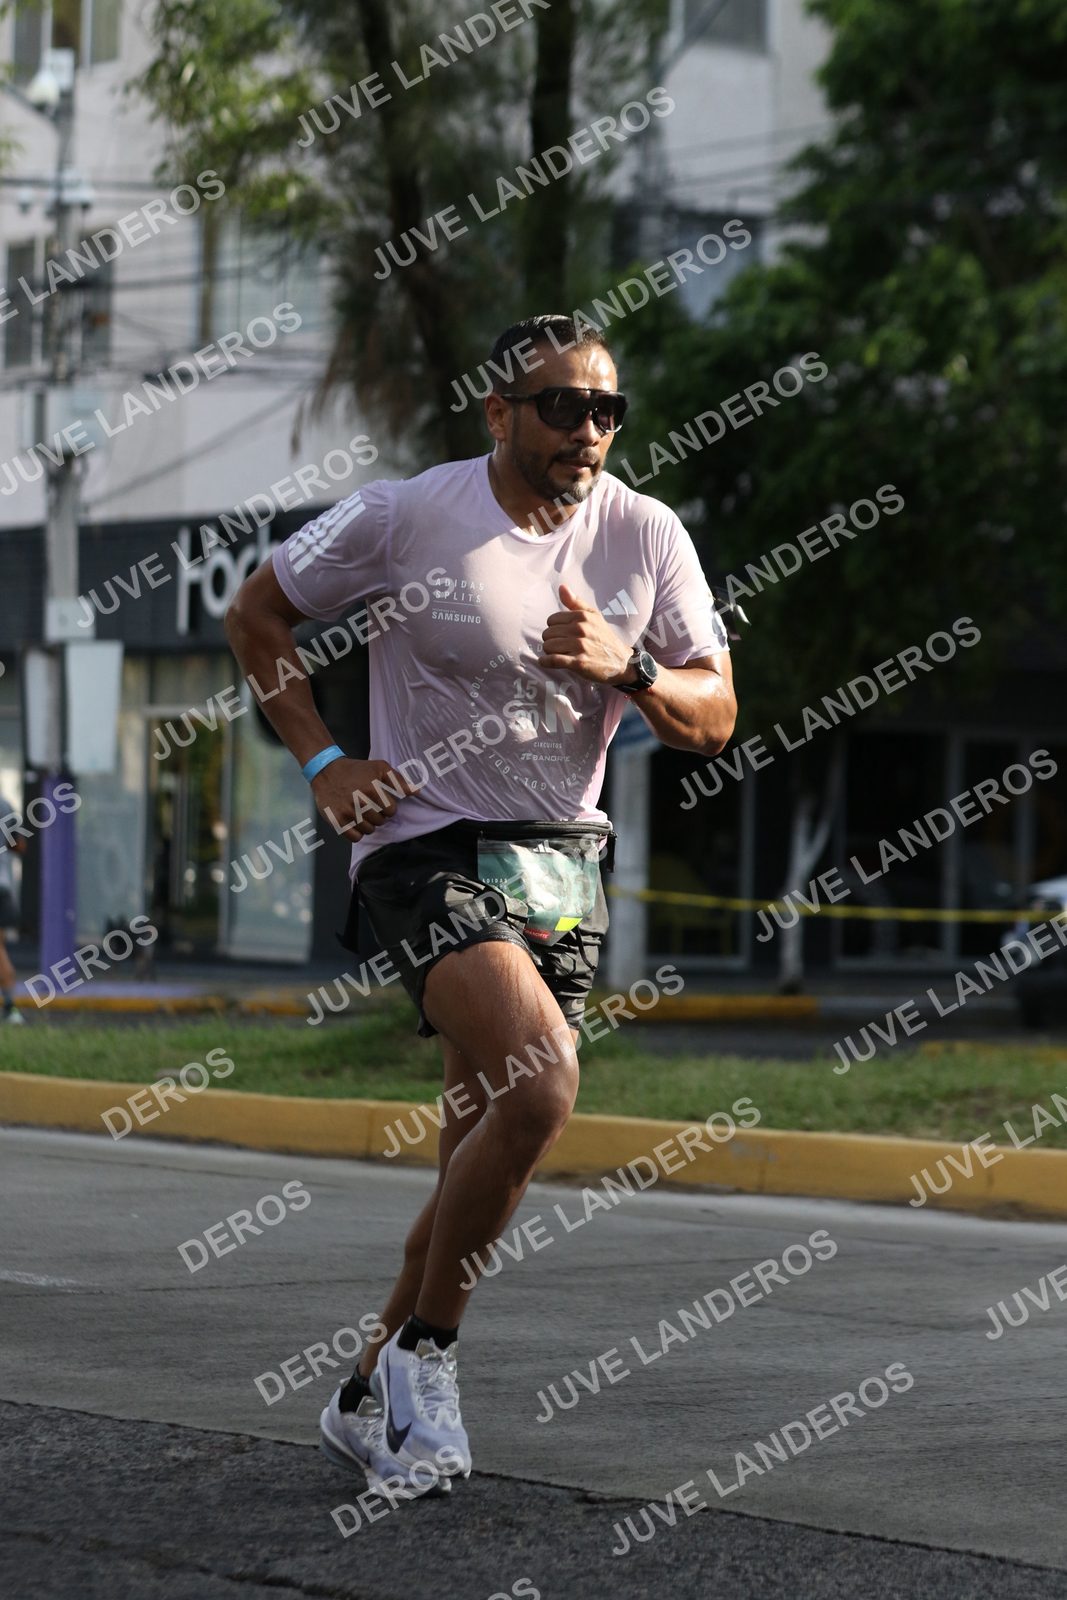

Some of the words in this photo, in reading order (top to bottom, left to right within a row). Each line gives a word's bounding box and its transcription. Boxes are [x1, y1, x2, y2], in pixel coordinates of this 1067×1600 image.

[435, 578, 485, 591] ADIDAS
[435, 590, 481, 603] SPLITS
[431, 611, 481, 624] SAMSUNG
[513, 677, 539, 700] 15
[545, 680, 576, 734] K
